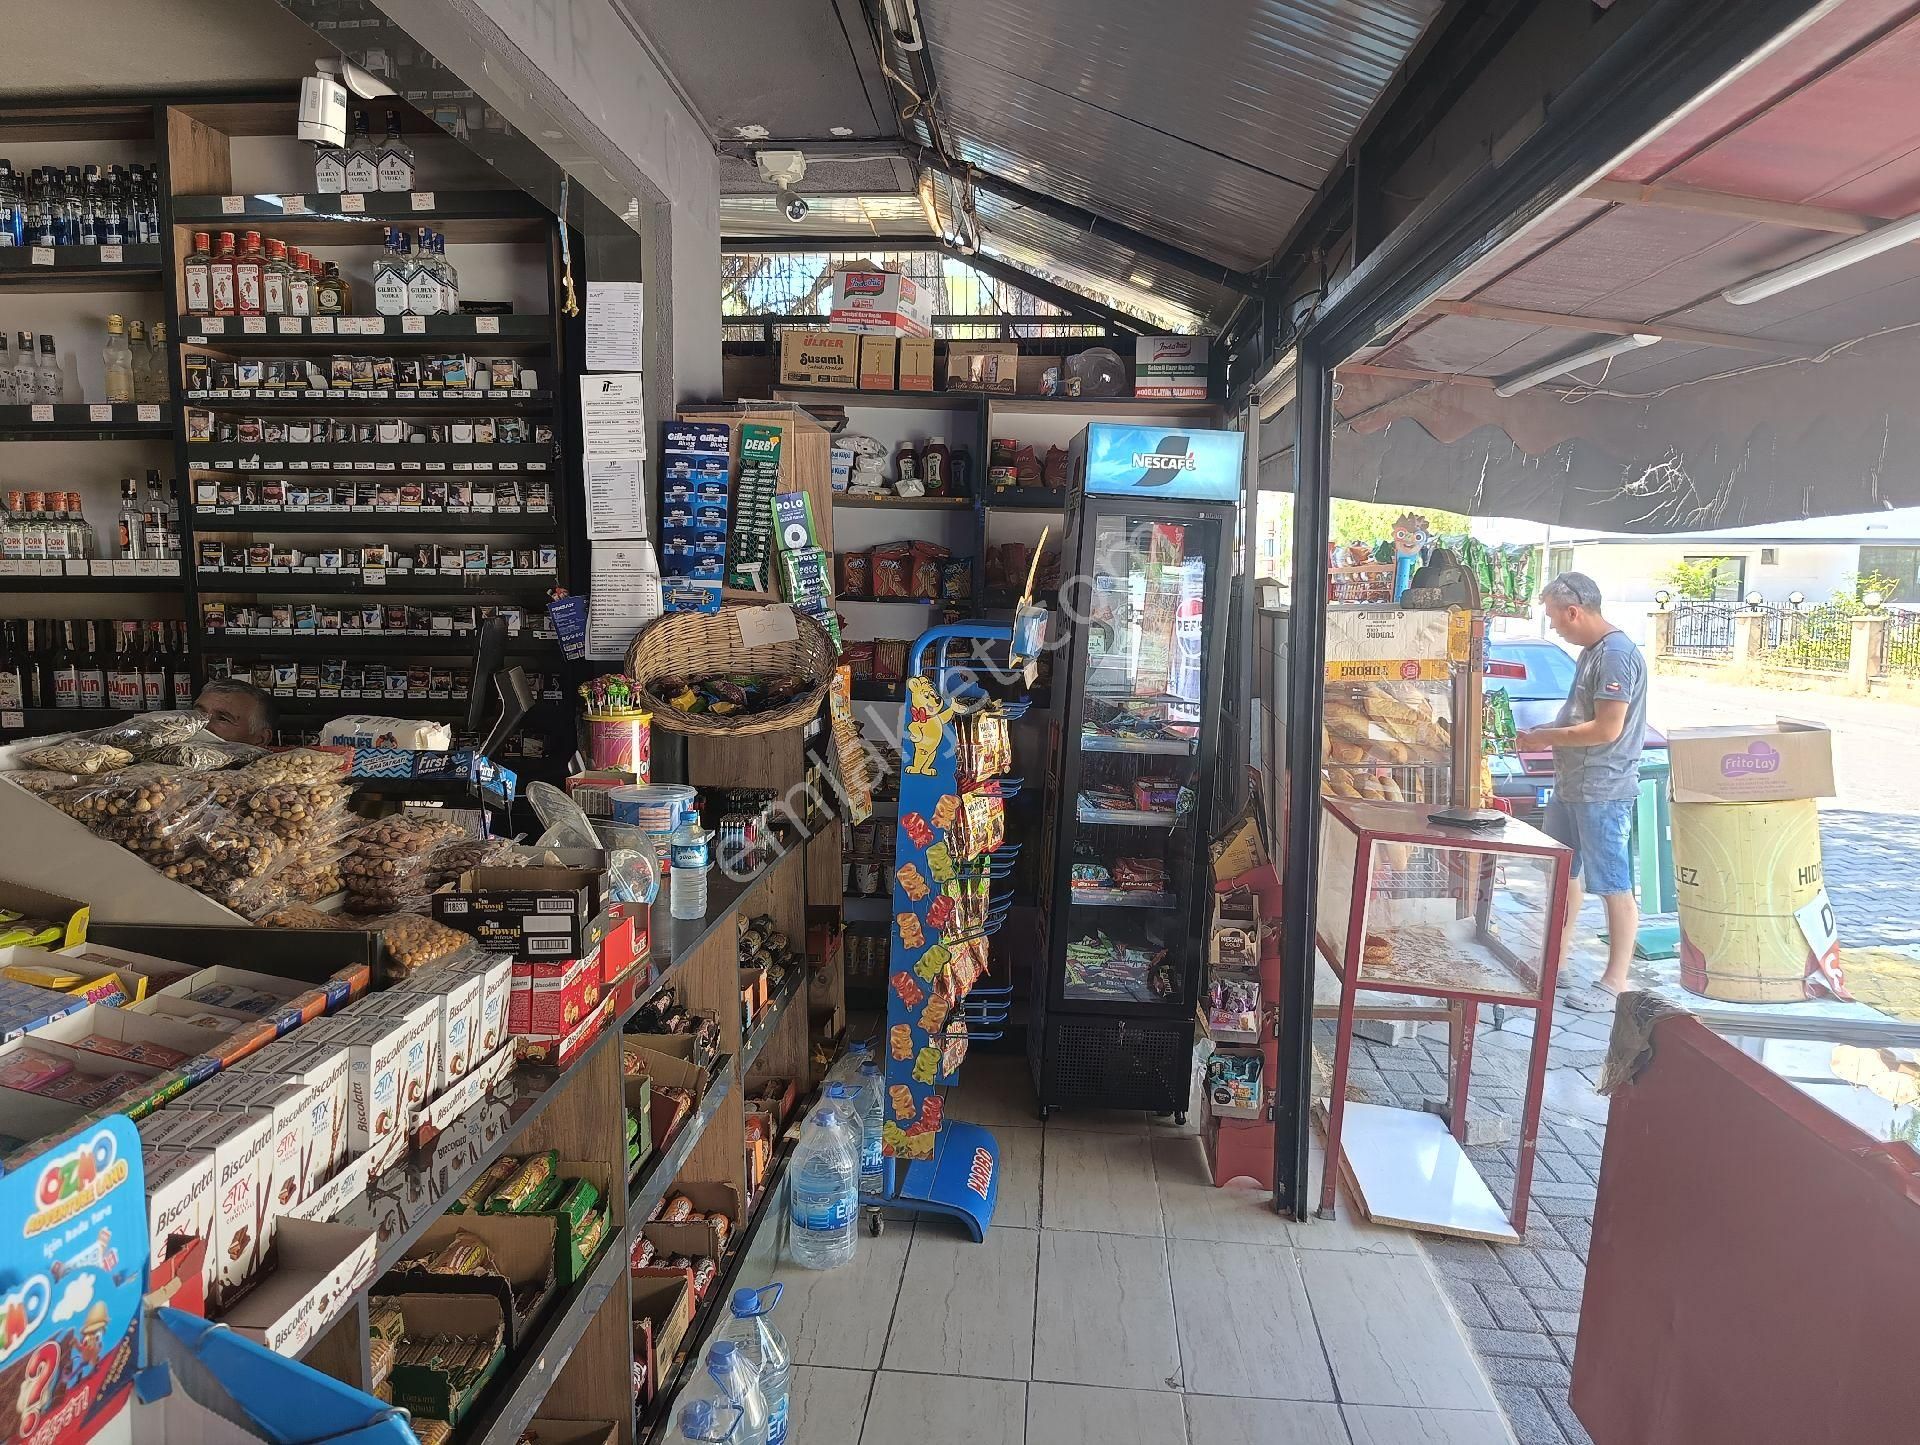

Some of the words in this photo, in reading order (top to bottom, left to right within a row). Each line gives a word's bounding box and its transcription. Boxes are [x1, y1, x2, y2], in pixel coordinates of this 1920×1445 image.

[804, 335, 843, 348] ÜLKER
[700, 434, 728, 442] Gillette
[745, 439, 777, 452] DERBY
[1132, 452, 1196, 470] NESCAFÉ
[776, 500, 803, 511] POLO
[1342, 666, 1388, 676] TUBORG
[418, 754, 449, 769] First
[1726, 756, 1754, 770] Frito
[1756, 758, 1776, 771] Lay
[472, 901, 503, 911] Browni
[478, 926, 520, 937] Browni
[450, 986, 480, 1019] Biscolata
[409, 1006, 438, 1041] iscolata
[374, 1032, 408, 1076] Biscolata
[312, 1060, 348, 1100] iscolata
[374, 1068, 395, 1100] STIX
[277, 1095, 312, 1135] Biscolata
[353, 1081, 368, 1133] Biscolata
[437, 1086, 466, 1122] Biscolata
[221, 1126, 273, 1187] Biscolata
[276, 1128, 298, 1159] STIX
[40, 1137, 112, 1205] OZMO
[968, 1148, 993, 1200] HARIBO
[26, 1188, 94, 1234] ADVENTURE
[97, 1160, 126, 1197] LAND
[156, 1168, 214, 1237] Biscolata
[222, 1174, 252, 1214] STIX
[0, 1279, 48, 1349] MO
[274, 1295, 314, 1351] Biscolata
